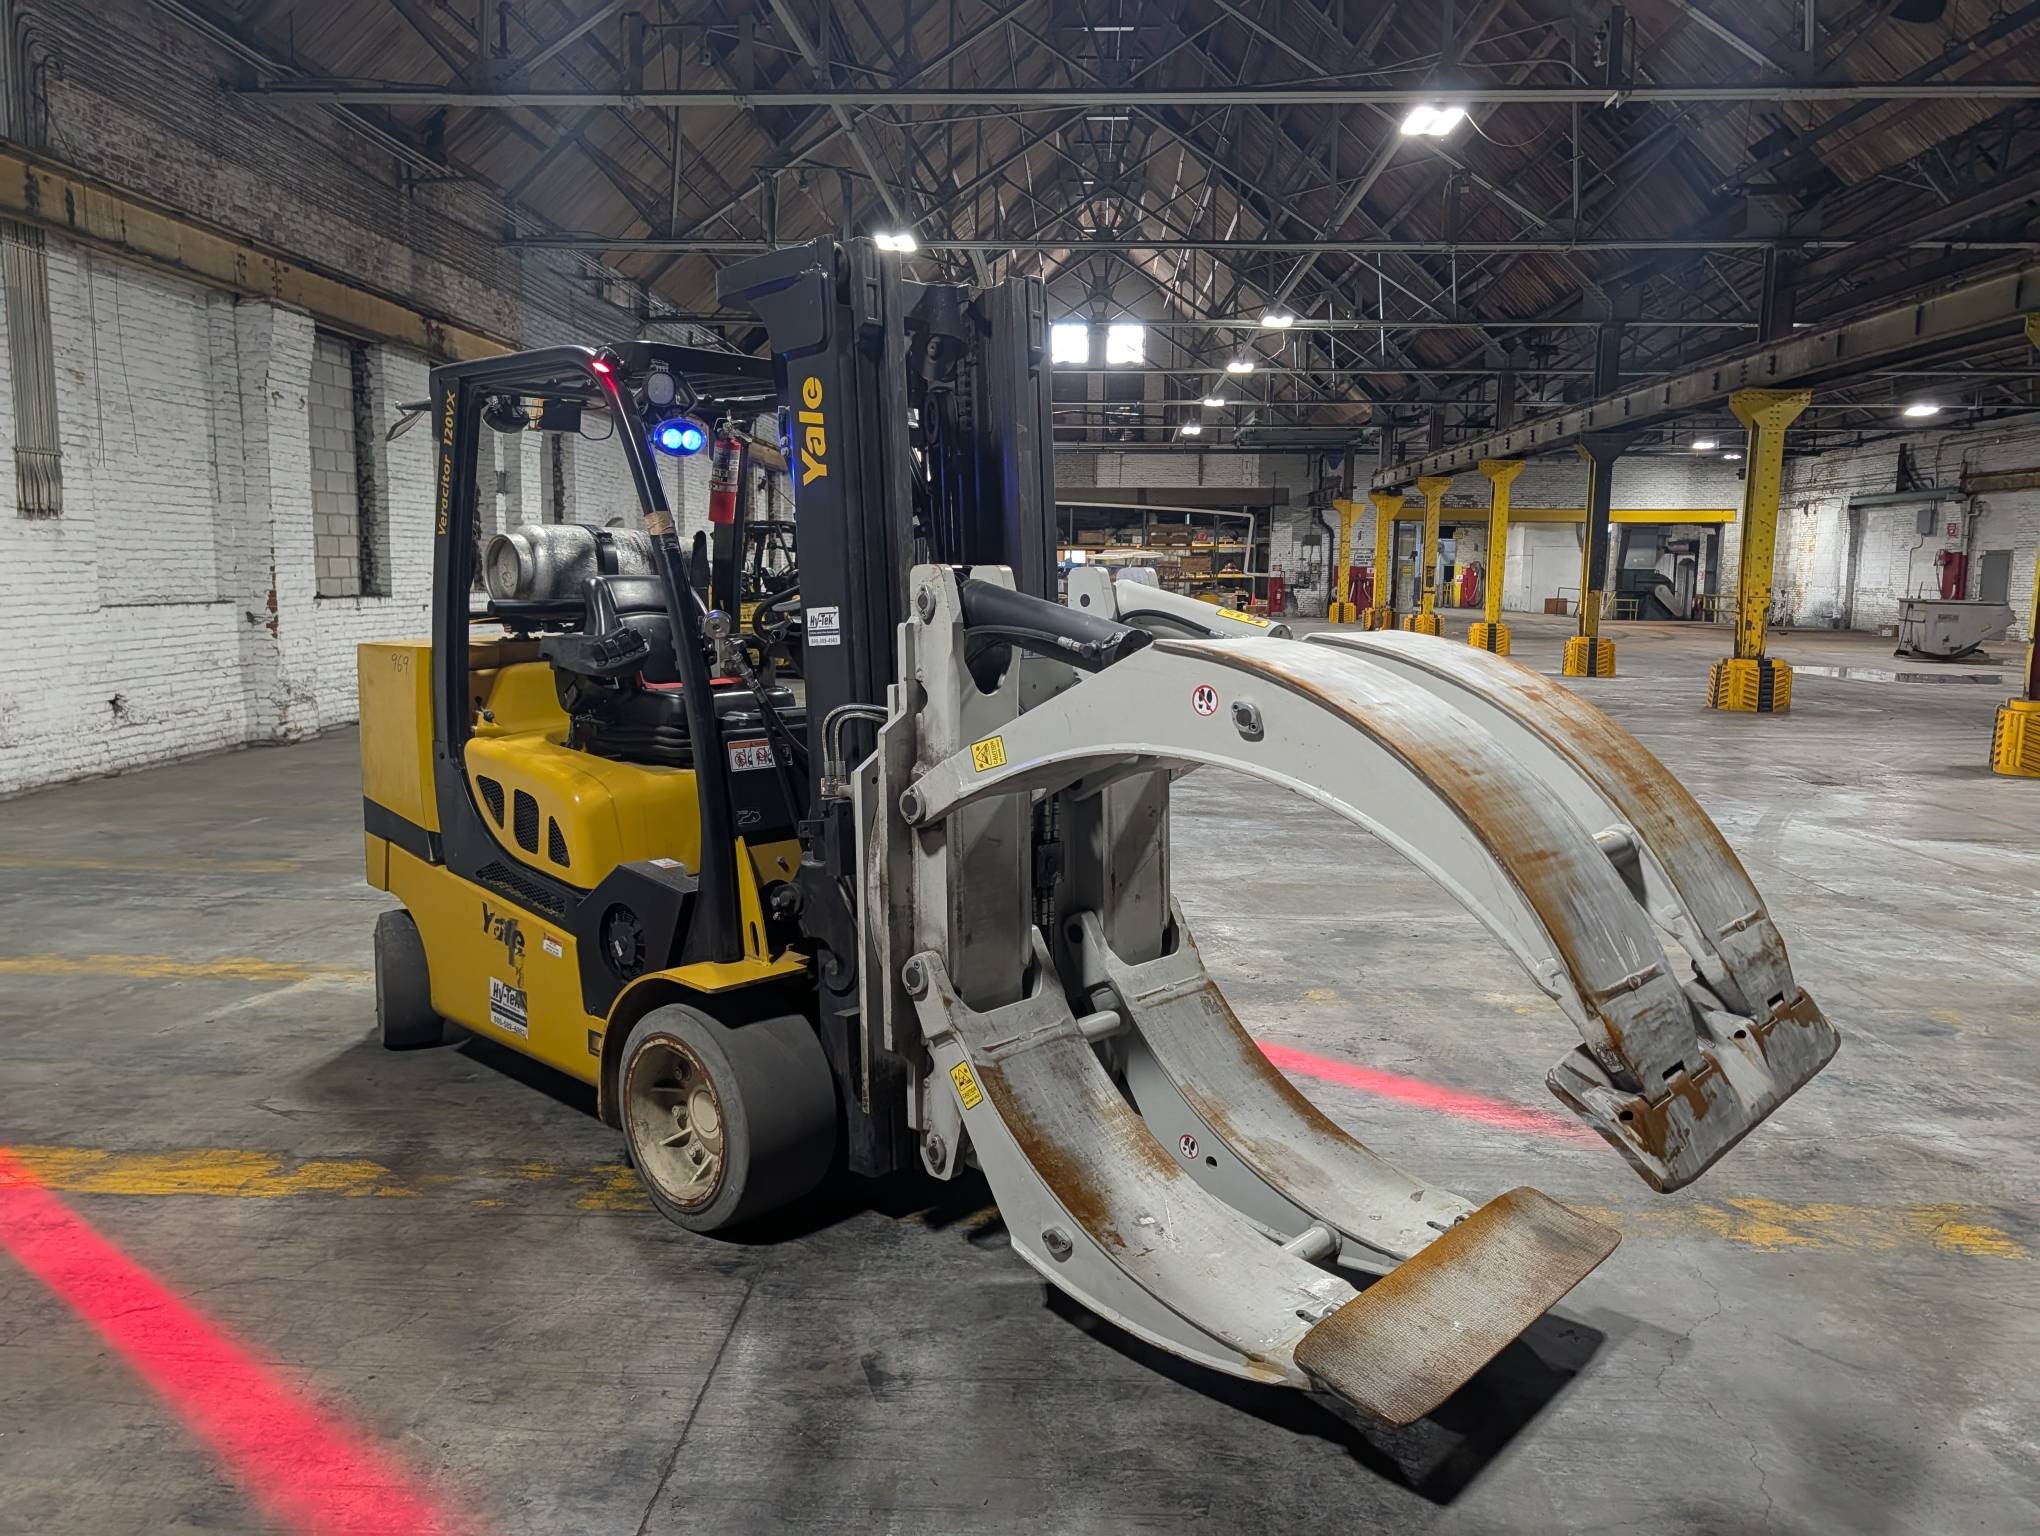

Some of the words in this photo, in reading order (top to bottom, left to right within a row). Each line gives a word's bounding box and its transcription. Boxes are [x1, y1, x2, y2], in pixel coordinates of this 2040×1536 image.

[443, 389, 456, 446] 120VX
[799, 376, 828, 486] Yale
[438, 454, 452, 536] Veracitor
[810, 614, 833, 628] Hy-Tek
